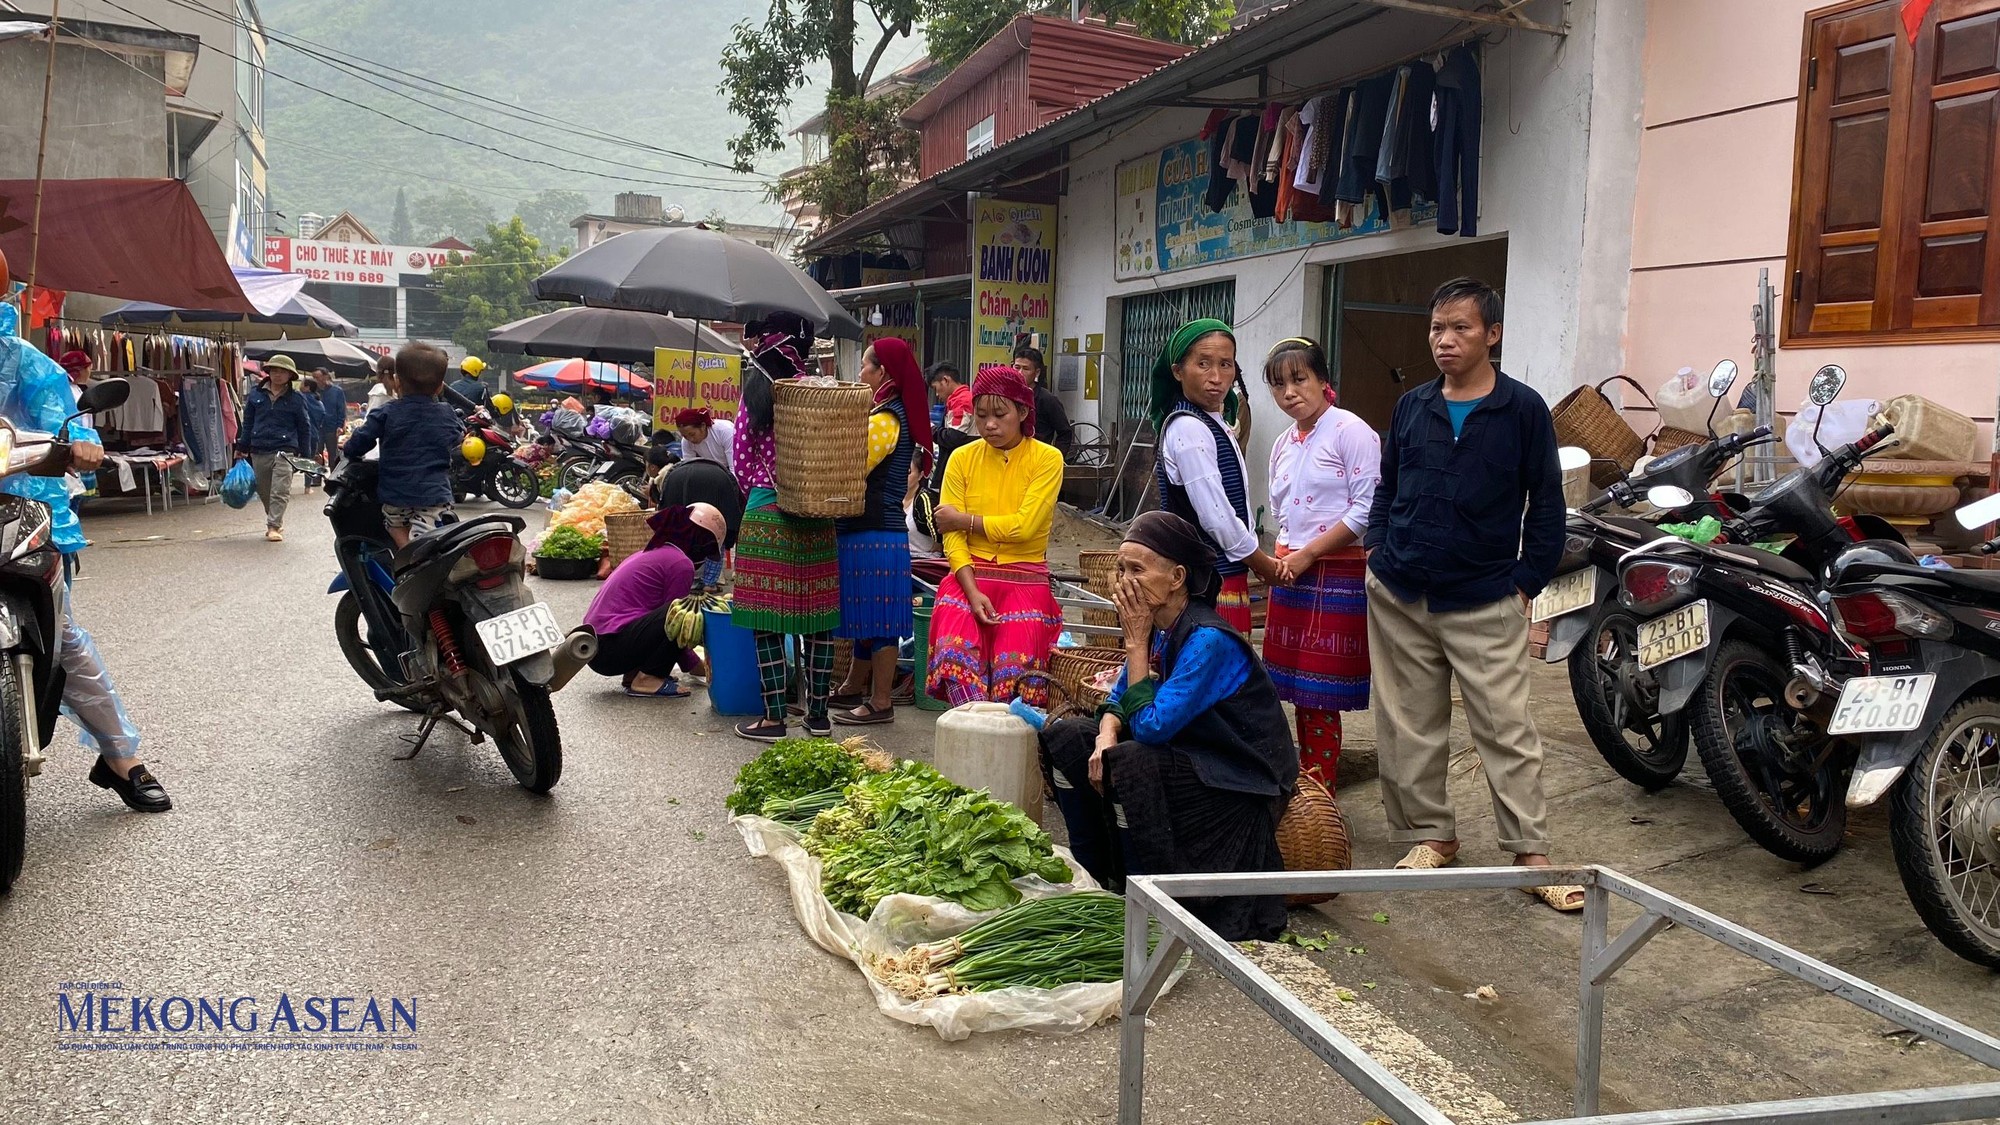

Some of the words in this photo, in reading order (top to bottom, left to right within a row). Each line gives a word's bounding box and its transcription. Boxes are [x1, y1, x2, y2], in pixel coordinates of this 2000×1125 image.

[266, 252, 284, 263] ÓP
[296, 245, 318, 261] CHO
[322, 246, 349, 264] THUÊ
[353, 248, 367, 265] XE
[370, 248, 394, 267] MÁY
[980, 234, 1015, 281] BÁNH
[1016, 231, 1051, 284] CUỐN
[334, 271, 354, 281] 119
[359, 272, 384, 283] 689
[979, 287, 1011, 317] Chấm
[1021, 293, 1049, 318] Canh
[656, 375, 697, 400] BÁNH
[701, 377, 740, 403] CUỐN
[489, 609, 542, 640] 23-P1
[1649, 607, 1694, 643] 23-B1
[492, 626, 559, 660] 074.36
[1882, 664, 1912, 672] HONDA
[1852, 677, 1919, 704] 23-B1
[1835, 702, 1919, 730] 540.80
